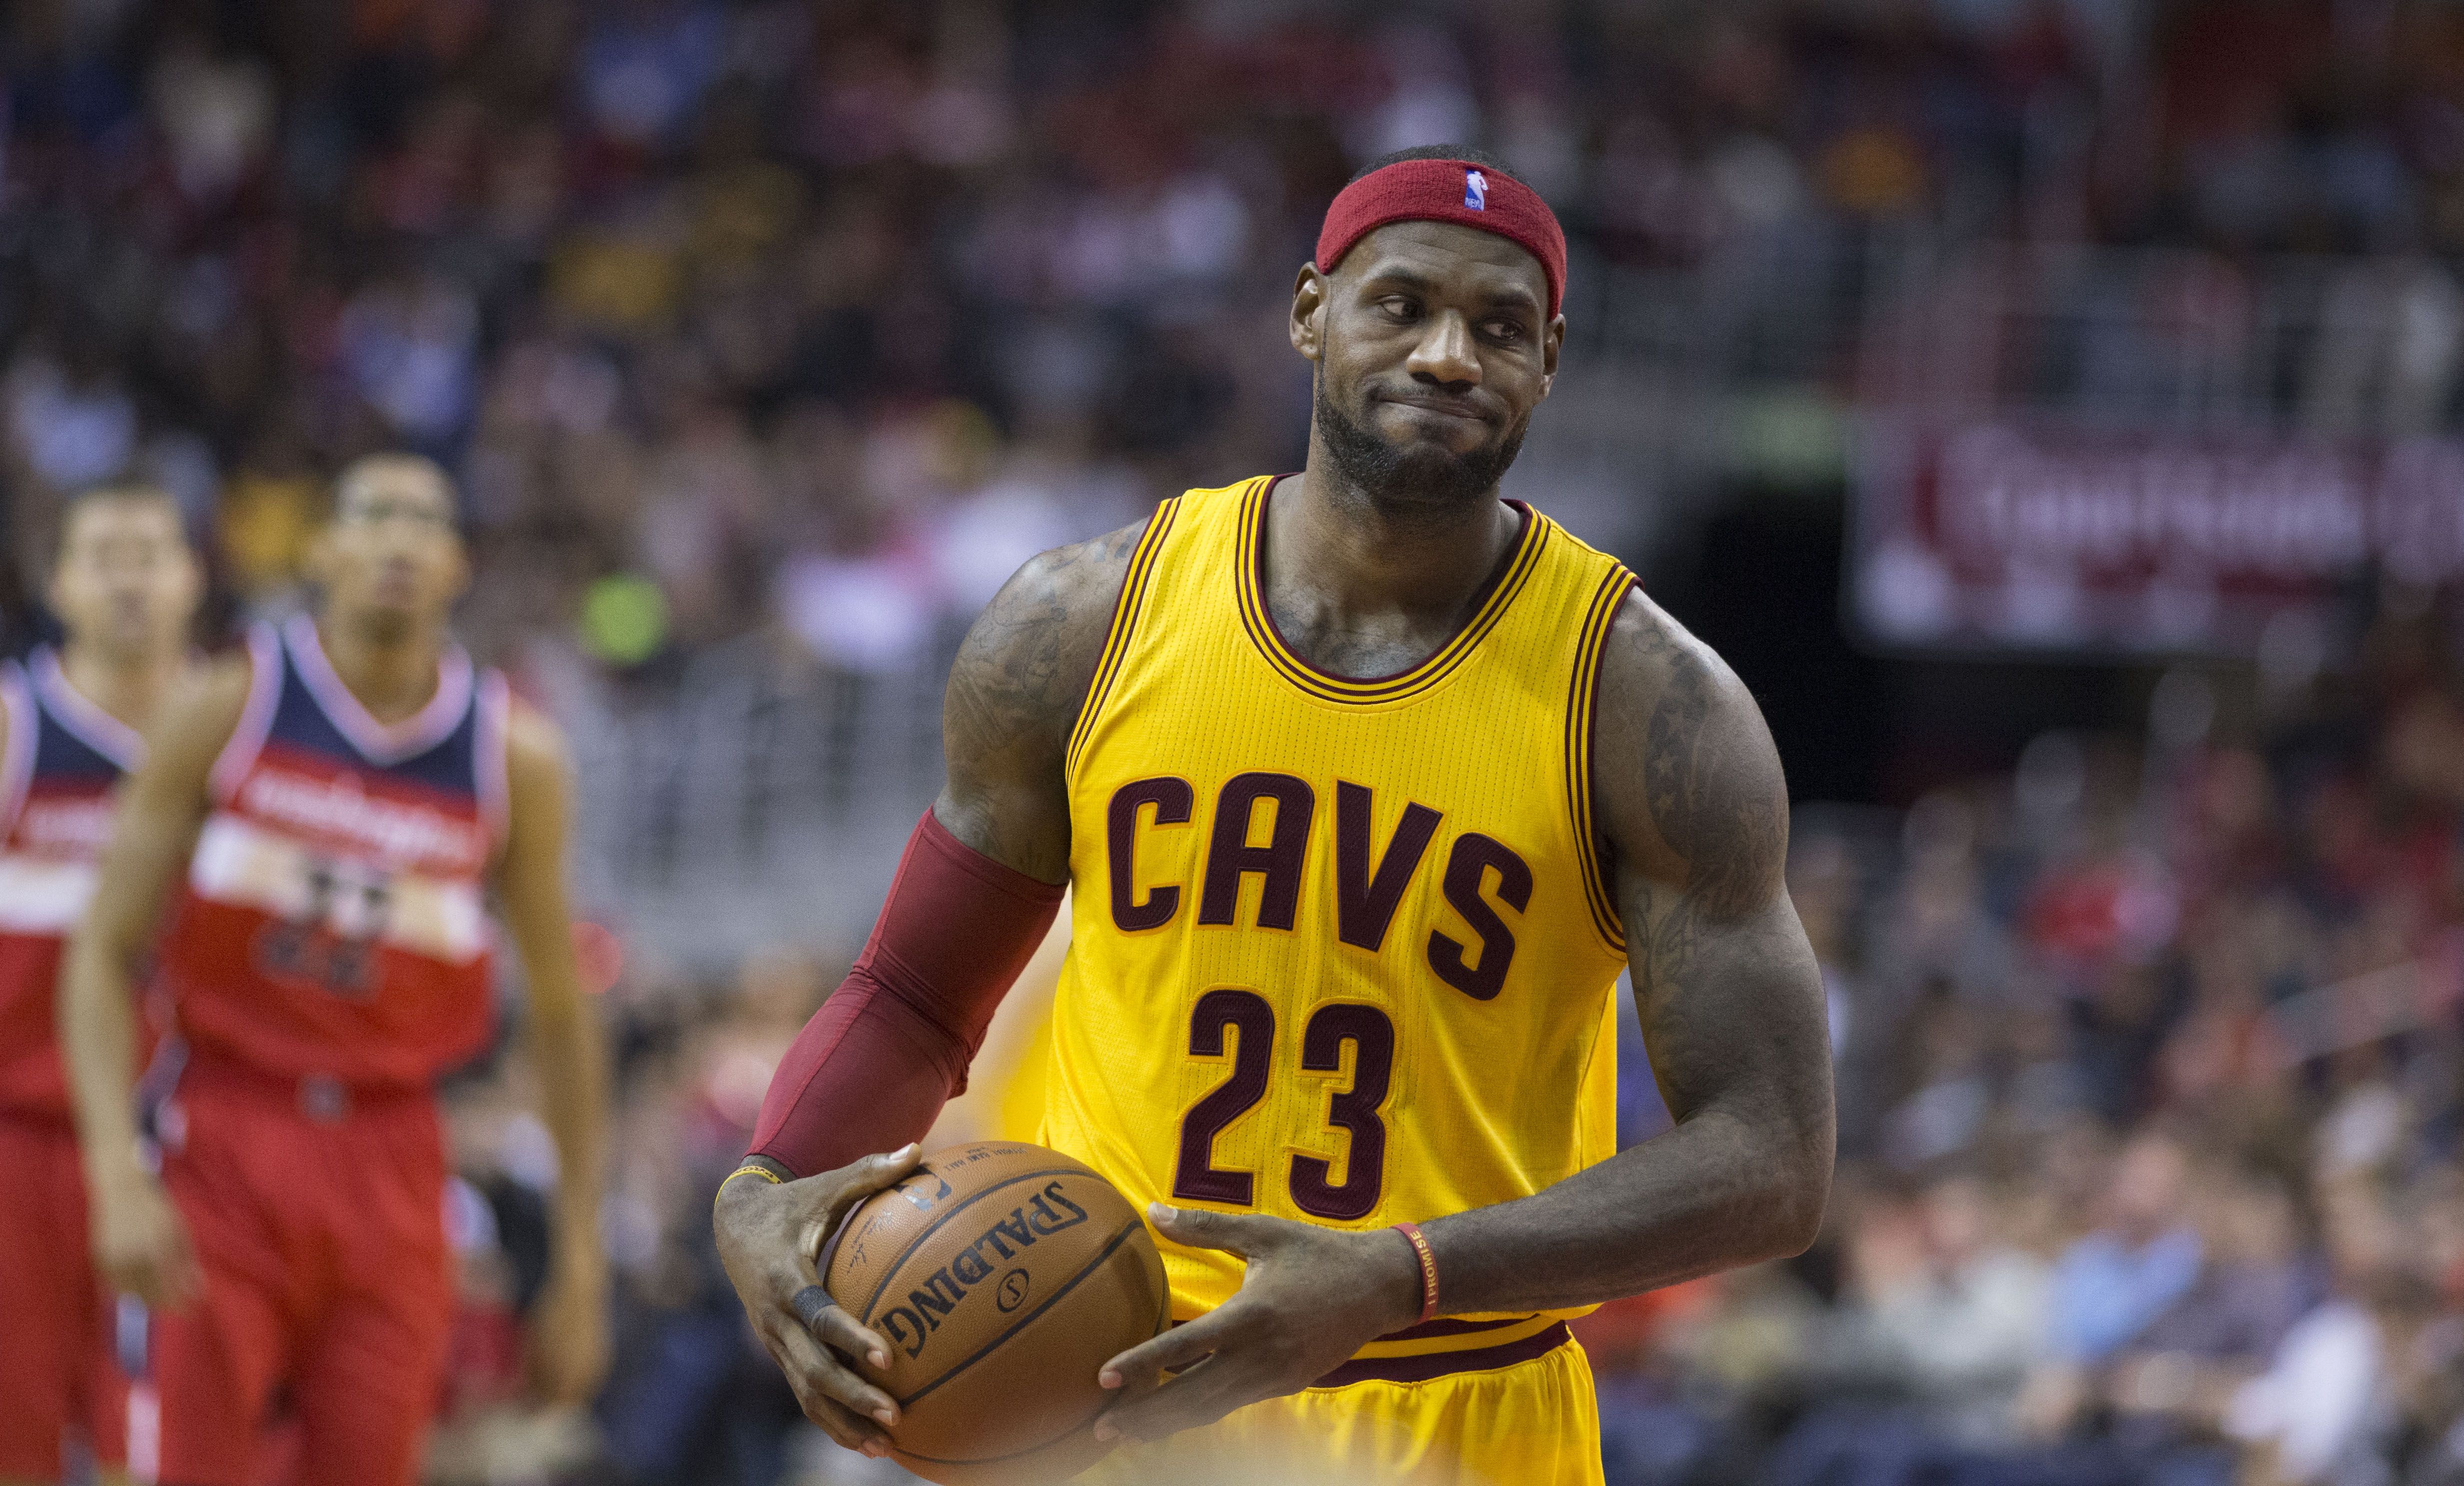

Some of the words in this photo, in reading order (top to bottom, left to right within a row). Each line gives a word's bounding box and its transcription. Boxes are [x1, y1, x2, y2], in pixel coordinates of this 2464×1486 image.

[1106, 770, 1534, 1002] CAVS
[1171, 988, 1396, 1221] 23
[881, 1180, 1088, 1360] SPALDING
[1409, 1230, 1436, 1297] PROMISE
